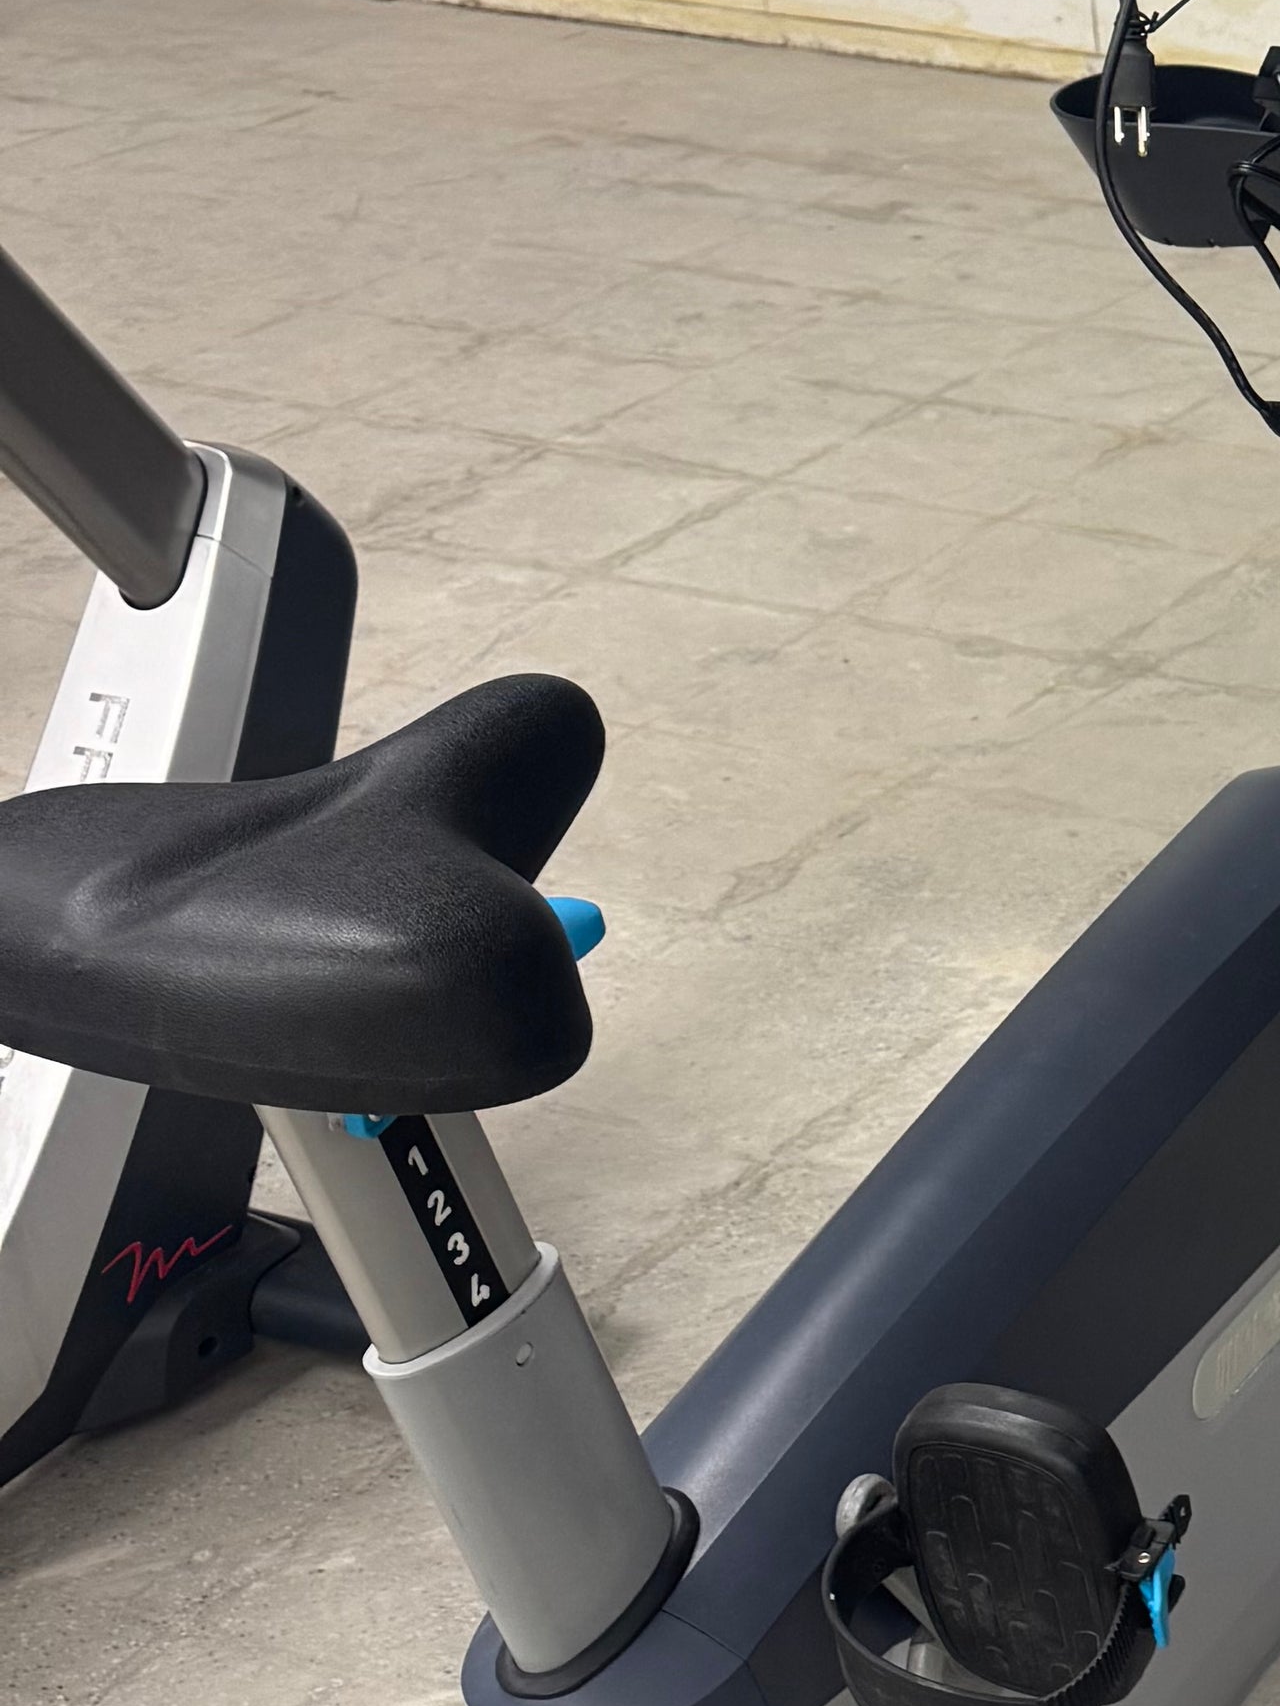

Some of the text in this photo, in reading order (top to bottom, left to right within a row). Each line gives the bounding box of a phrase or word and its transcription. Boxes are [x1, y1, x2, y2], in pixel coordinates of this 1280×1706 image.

[407, 1145, 429, 1176] 1
[427, 1189, 452, 1227] 2
[447, 1231, 470, 1266] 3
[470, 1273, 491, 1308] 4
